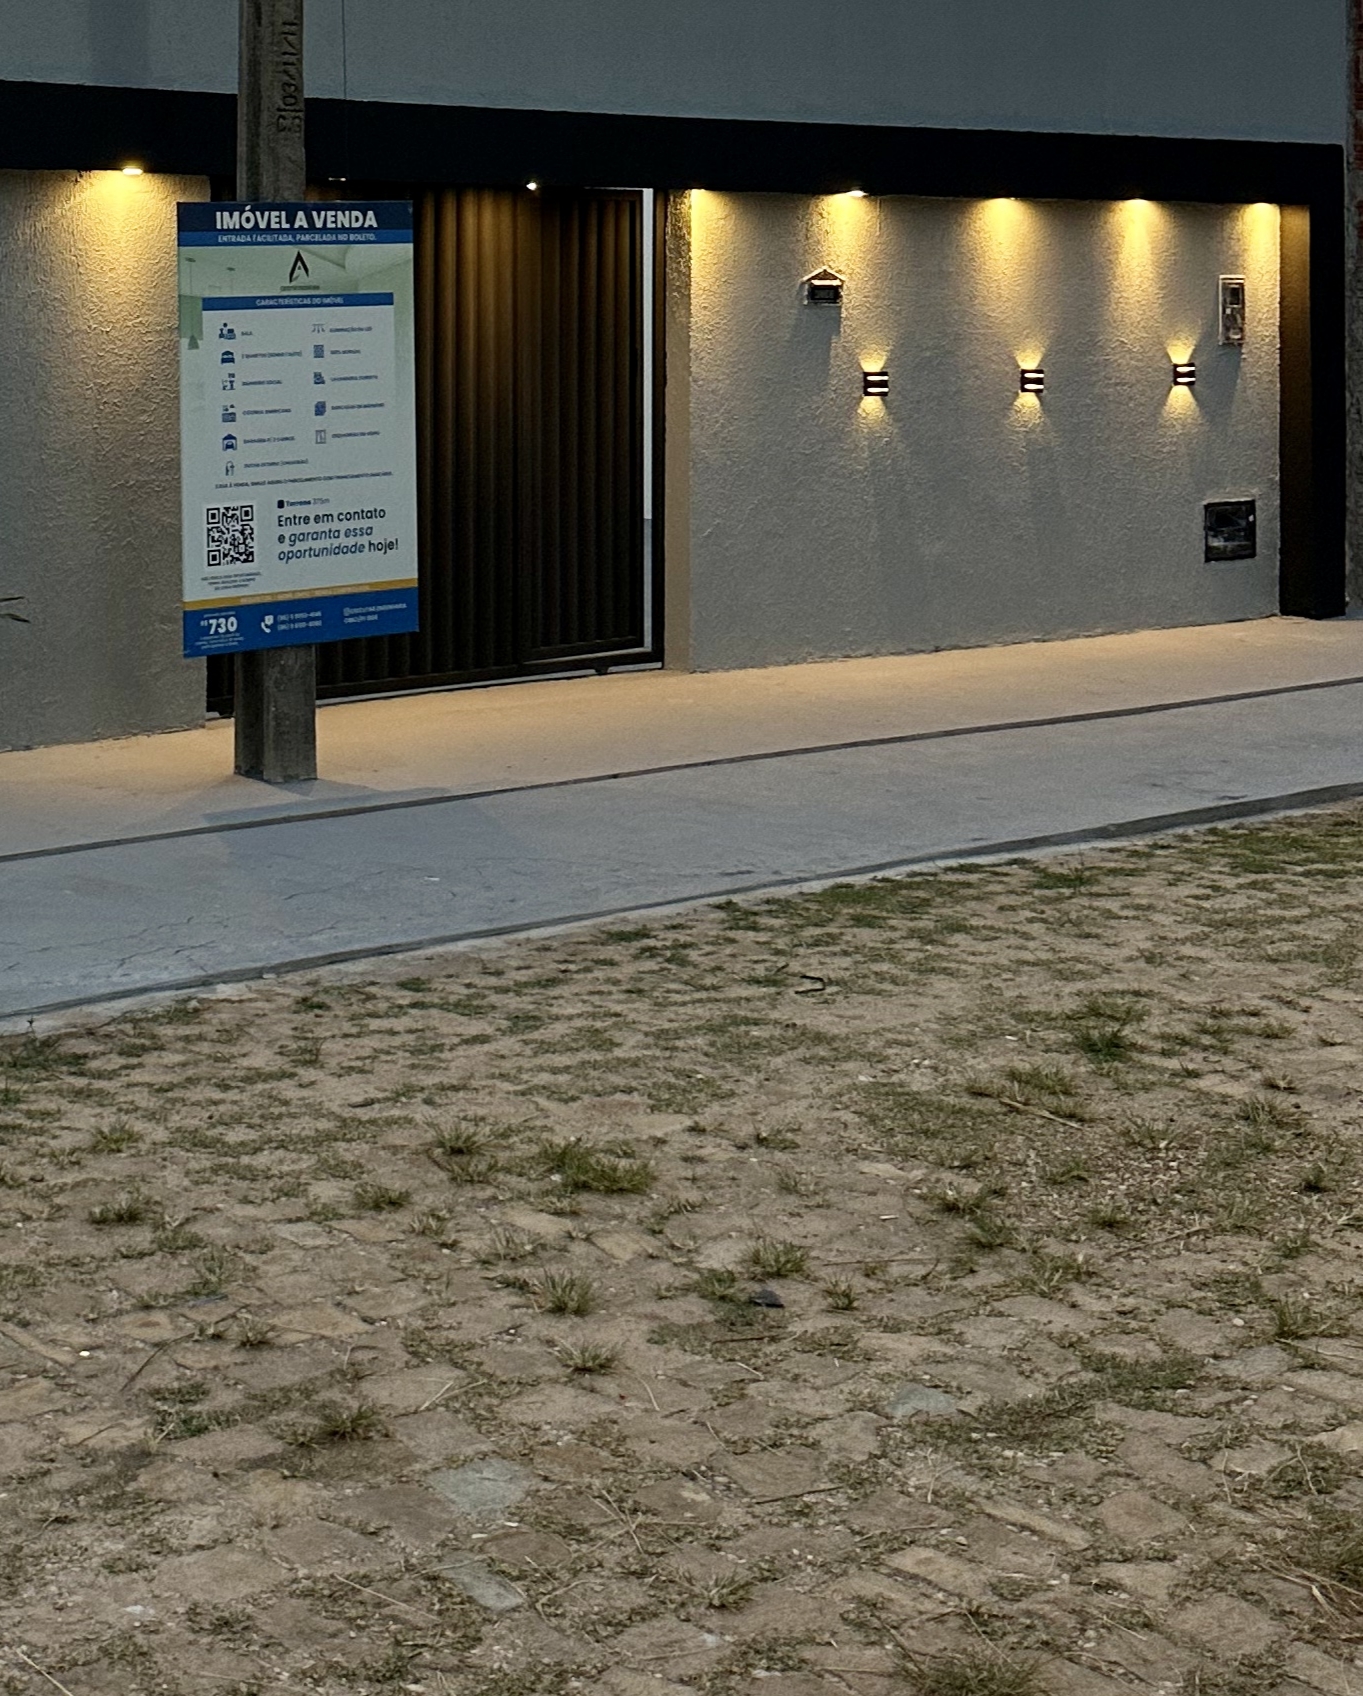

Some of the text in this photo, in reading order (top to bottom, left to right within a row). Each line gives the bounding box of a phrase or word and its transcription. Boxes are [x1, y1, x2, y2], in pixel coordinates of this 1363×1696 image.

[215, 205, 378, 229] IMÓVEL A VENDA
[218, 234, 252, 243] ENTRADA
[278, 507, 386, 527] Entre em contato
[278, 526, 373, 547] e garanta essa
[278, 537, 398, 564] oportunidade hoje!
[209, 616, 238, 634] 730
